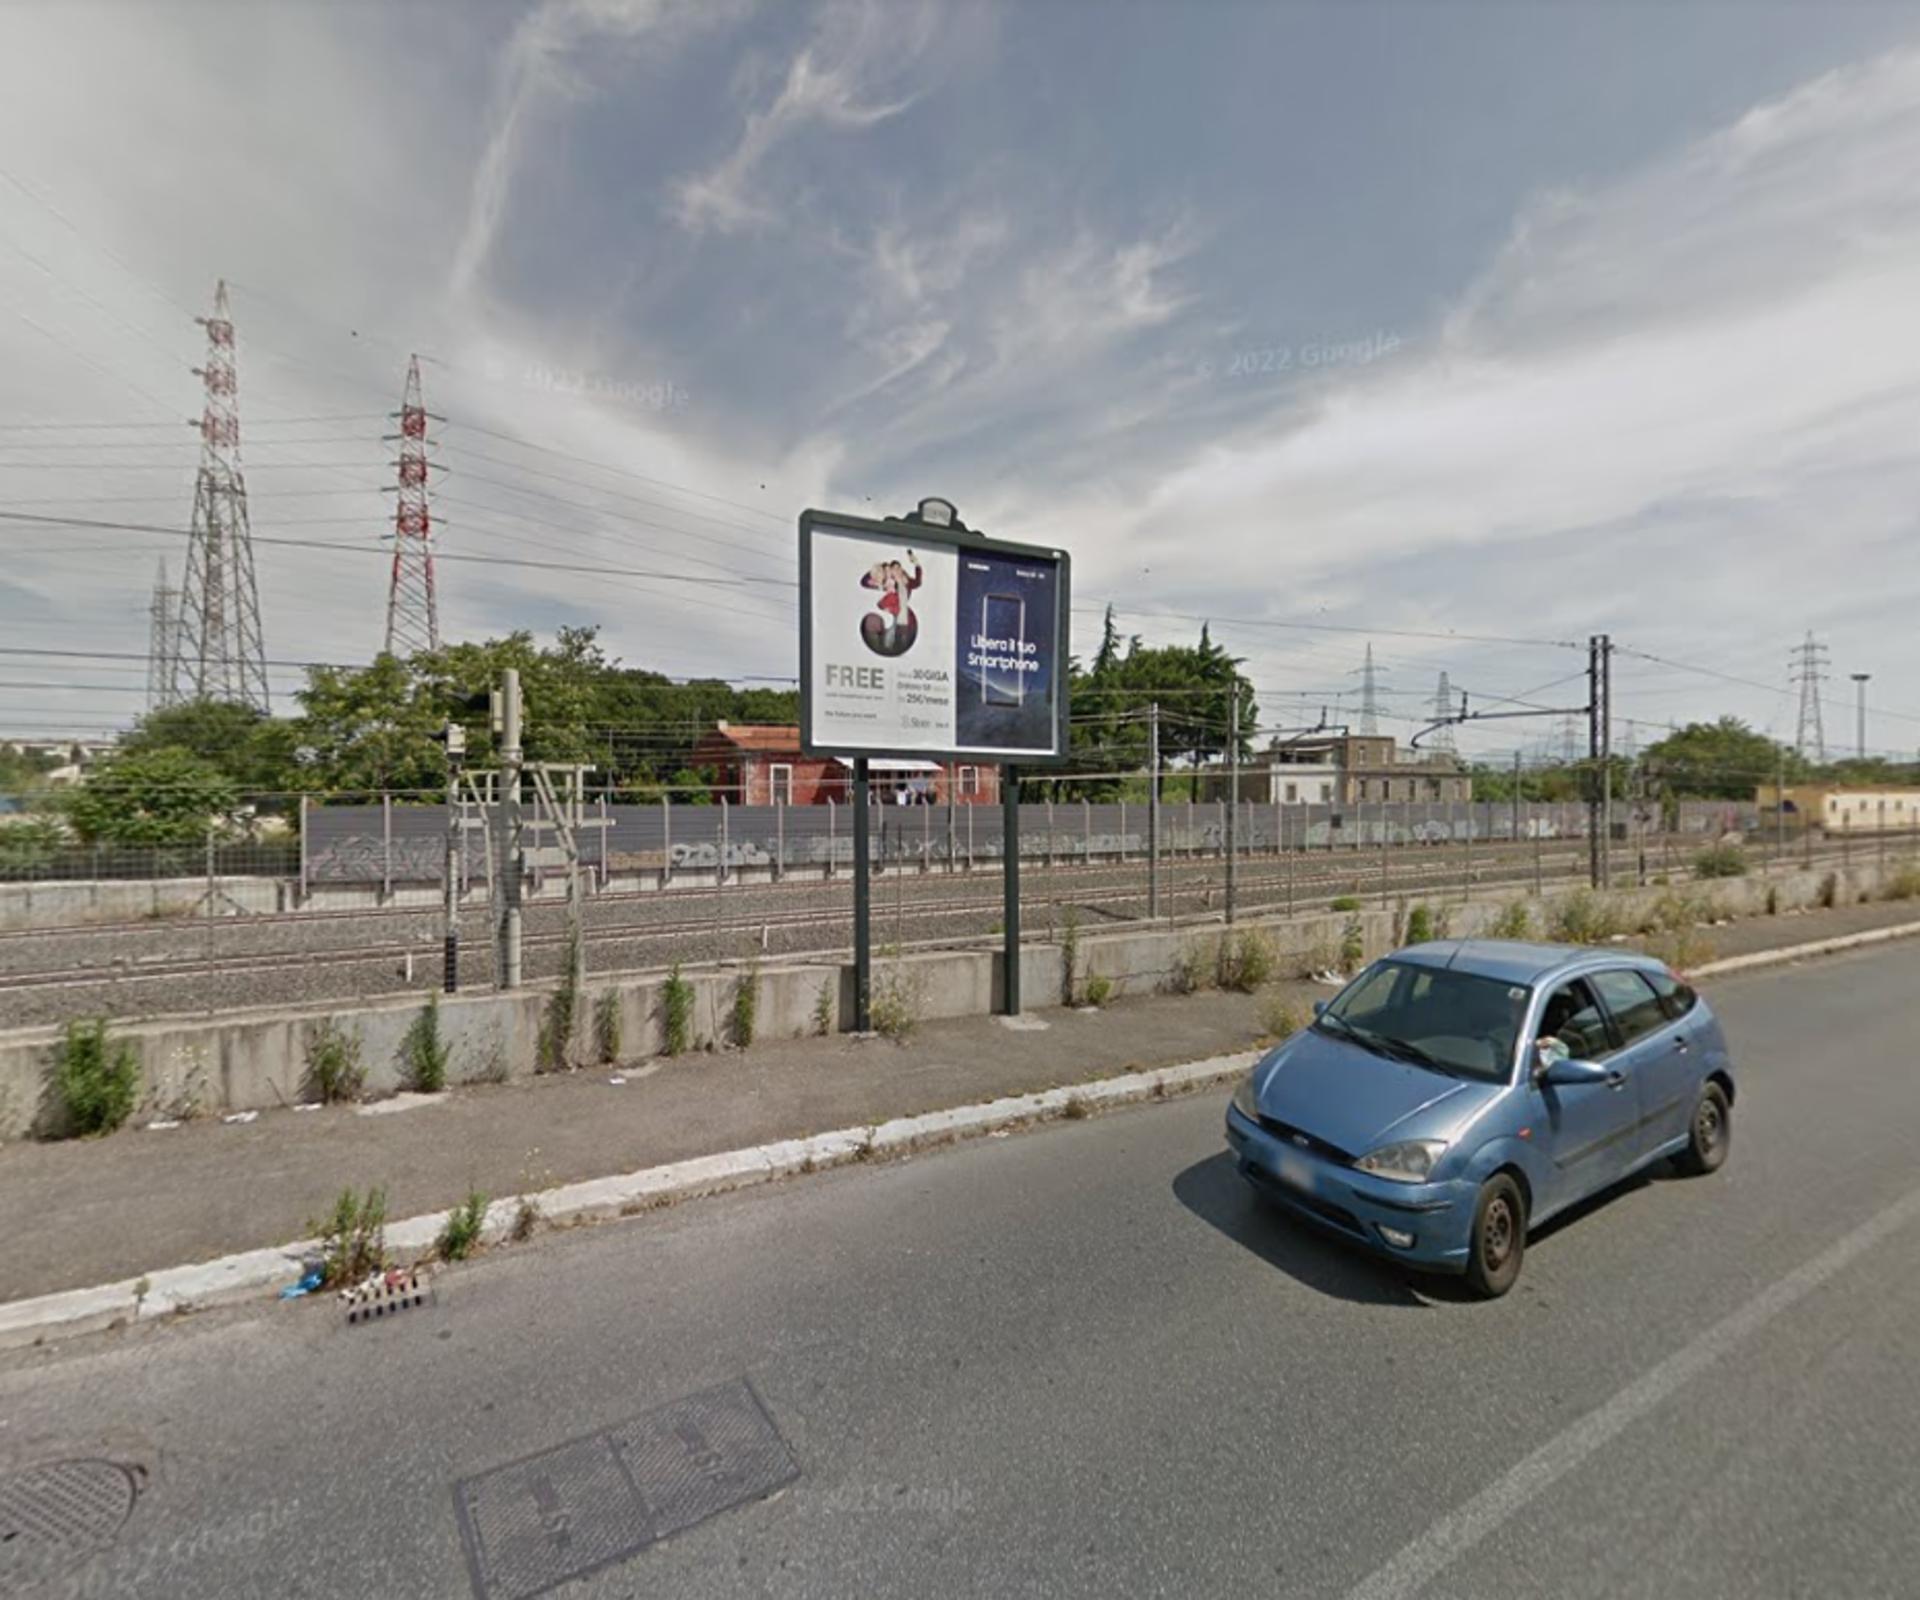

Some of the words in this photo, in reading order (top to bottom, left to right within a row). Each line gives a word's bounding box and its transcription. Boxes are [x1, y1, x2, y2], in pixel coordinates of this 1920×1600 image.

[971, 634, 1007, 651] Libera
[968, 652, 1039, 672] Smartphone
[825, 664, 884, 690] FREE
